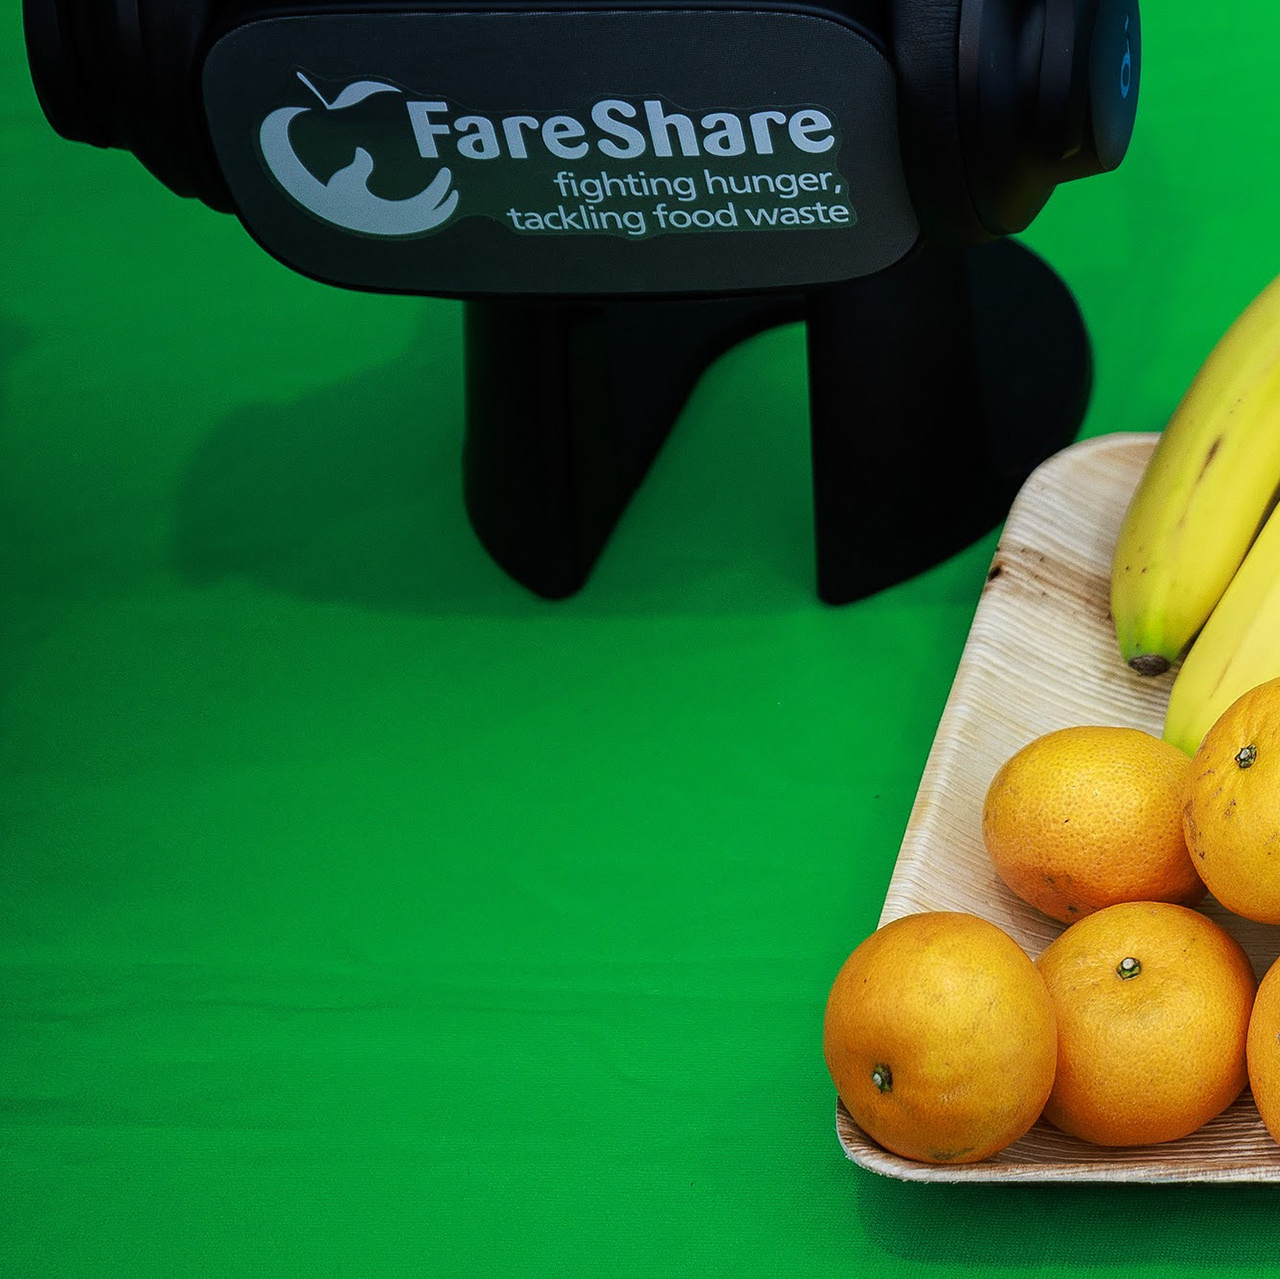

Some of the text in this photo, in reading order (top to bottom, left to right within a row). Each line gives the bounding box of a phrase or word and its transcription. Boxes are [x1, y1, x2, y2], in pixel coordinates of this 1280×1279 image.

[405, 97, 836, 161] FareShare
[553, 168, 842, 204] fighting hunger,
[507, 202, 850, 236] tackling food waste
